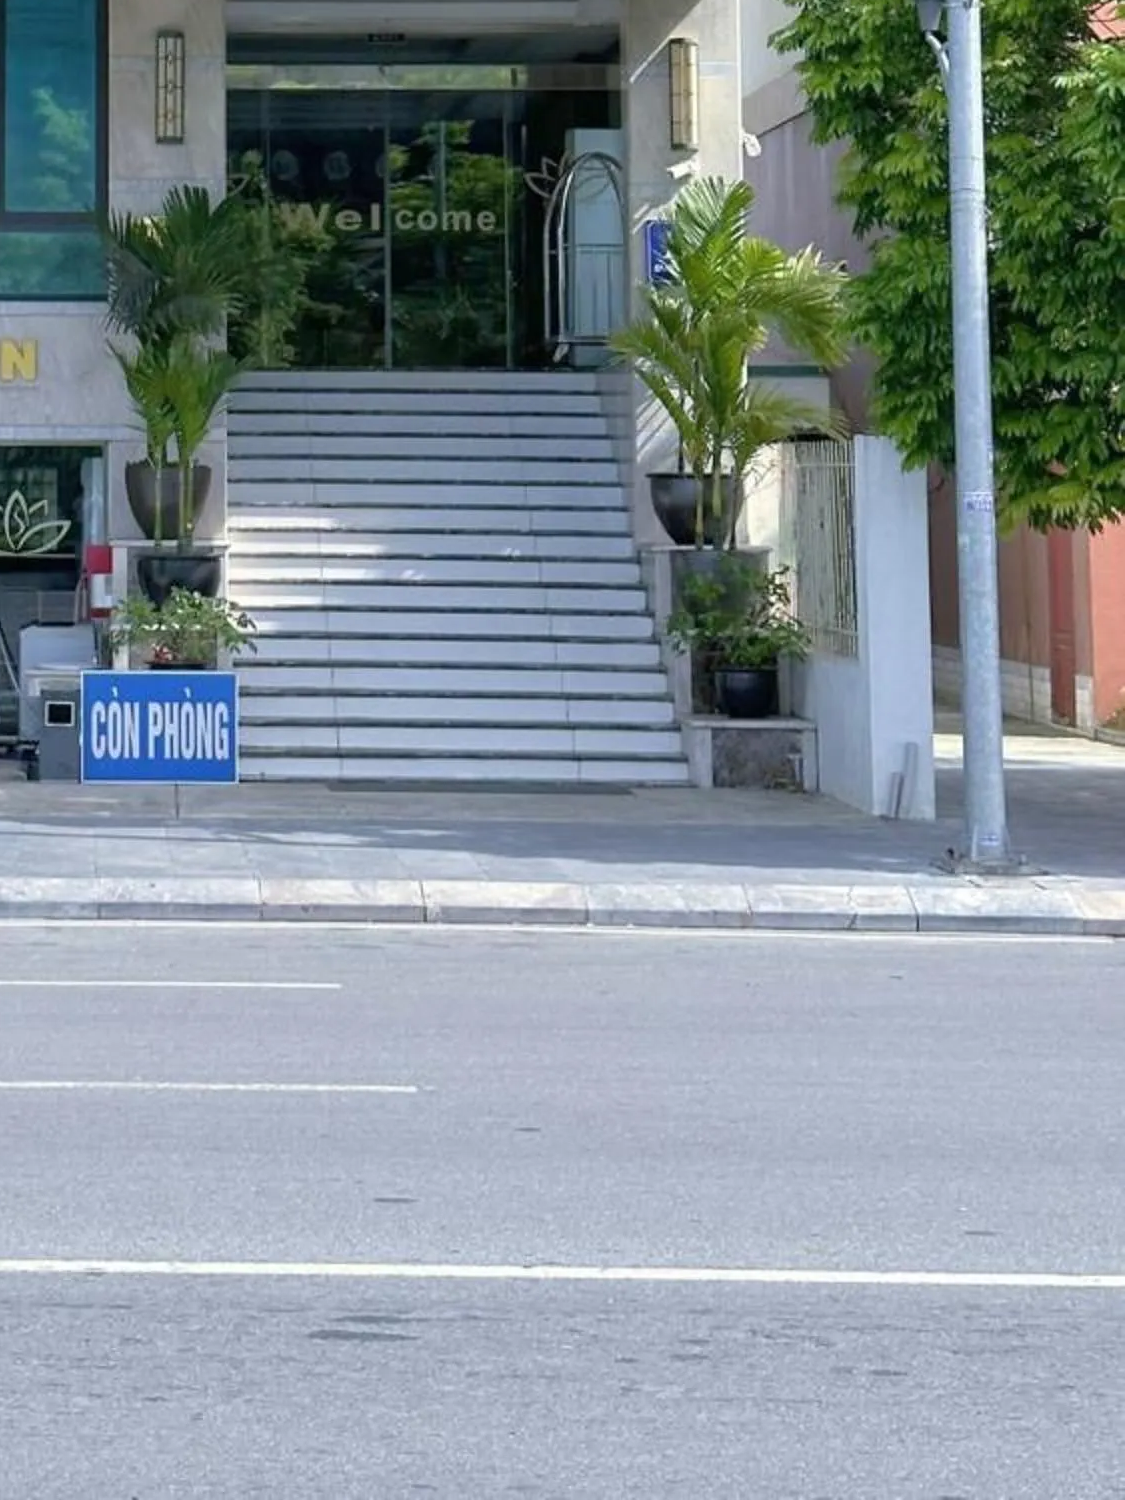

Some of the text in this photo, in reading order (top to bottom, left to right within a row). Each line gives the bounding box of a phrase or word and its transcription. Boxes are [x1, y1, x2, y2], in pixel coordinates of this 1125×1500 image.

[279, 202, 496, 232] Welcome
[91, 686, 230, 760] CÒN PHÒNG
